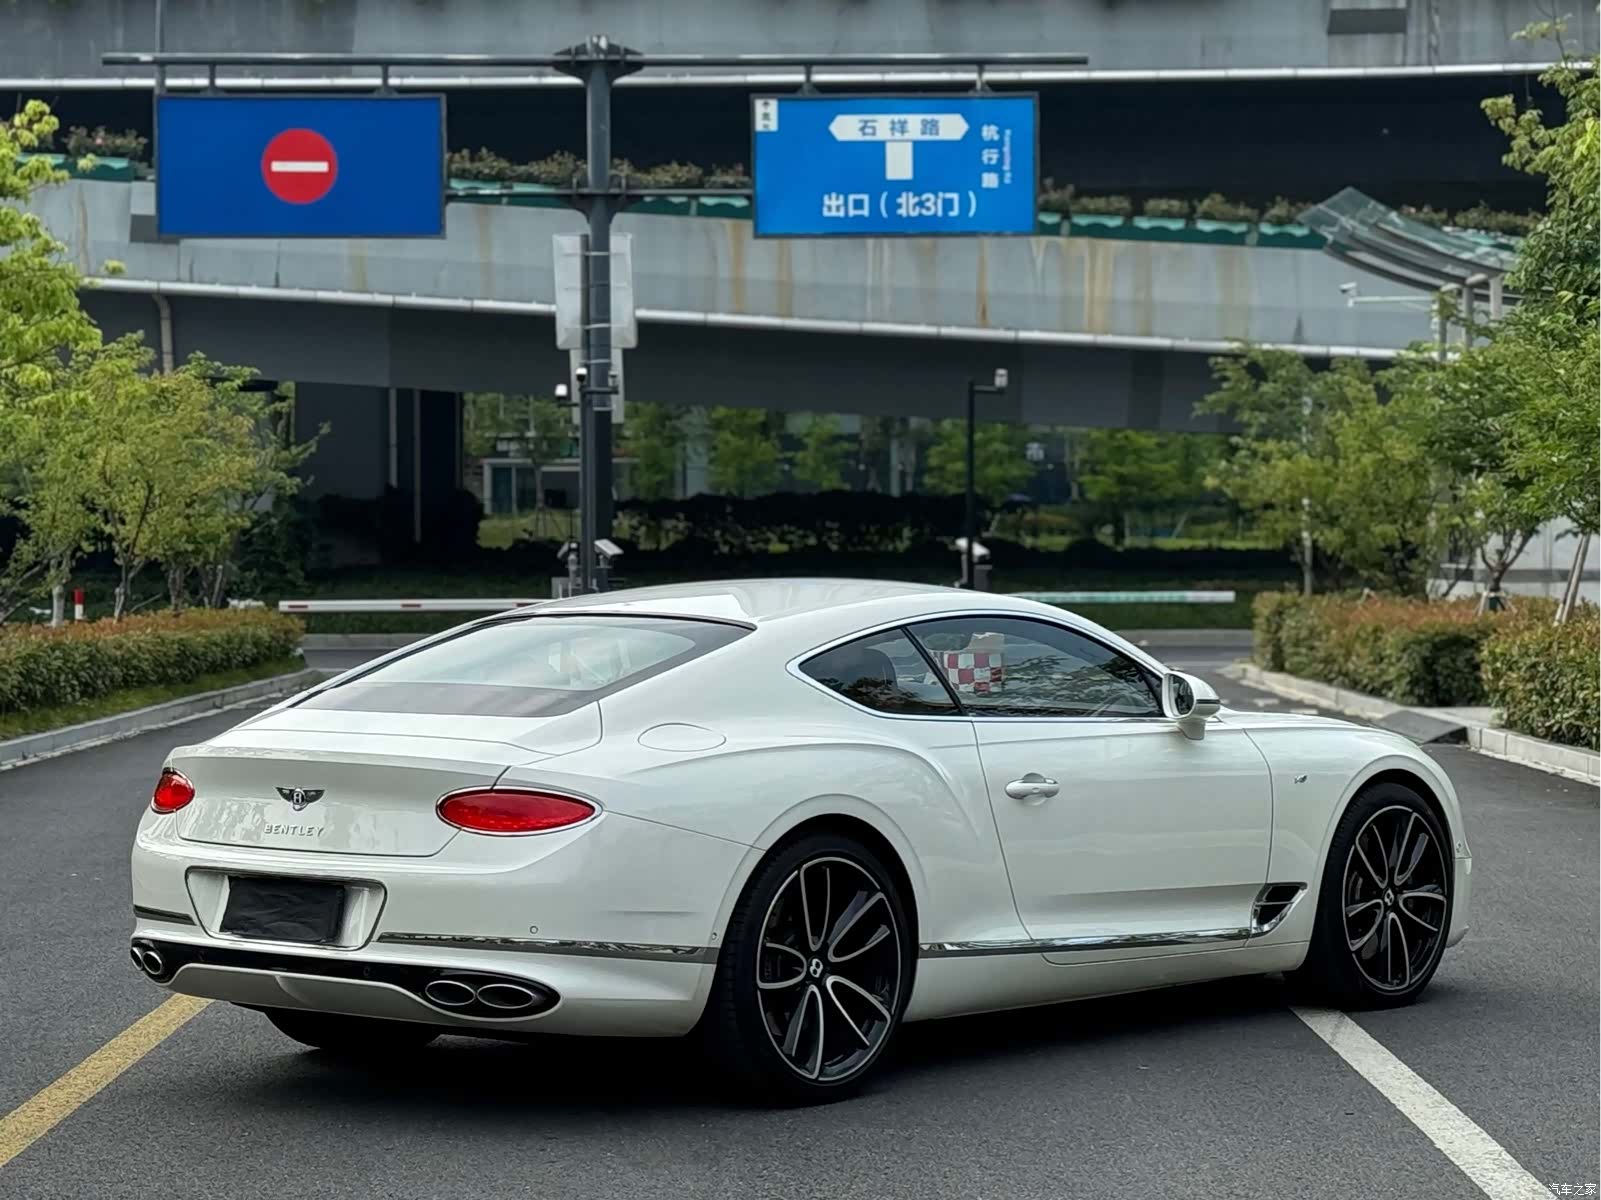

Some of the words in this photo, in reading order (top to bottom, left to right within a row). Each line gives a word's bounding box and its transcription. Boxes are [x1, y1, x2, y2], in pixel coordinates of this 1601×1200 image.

[858, 118, 941, 136] 石祥路
[263, 823, 325, 837] BENTLEY
